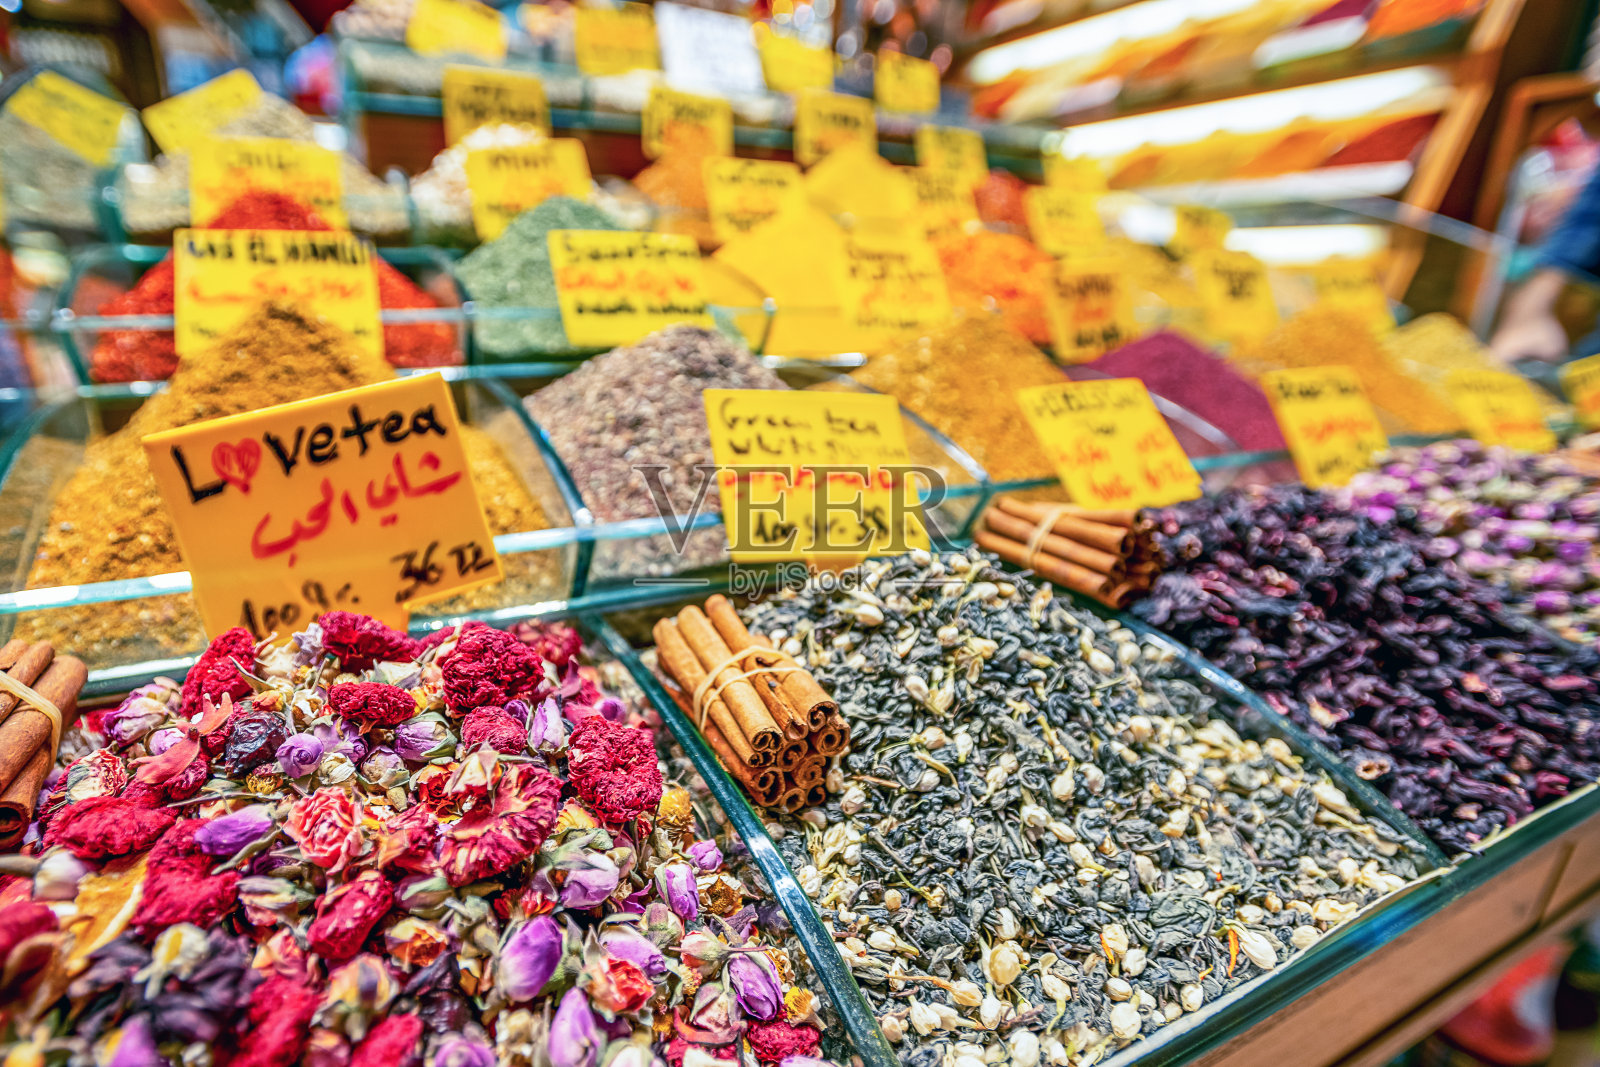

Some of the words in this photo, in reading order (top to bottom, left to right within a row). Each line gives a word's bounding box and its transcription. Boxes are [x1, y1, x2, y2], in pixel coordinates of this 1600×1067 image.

[251, 476, 359, 568] الحب
[365, 450, 463, 528] شاي
[389, 539, 444, 604] 36
